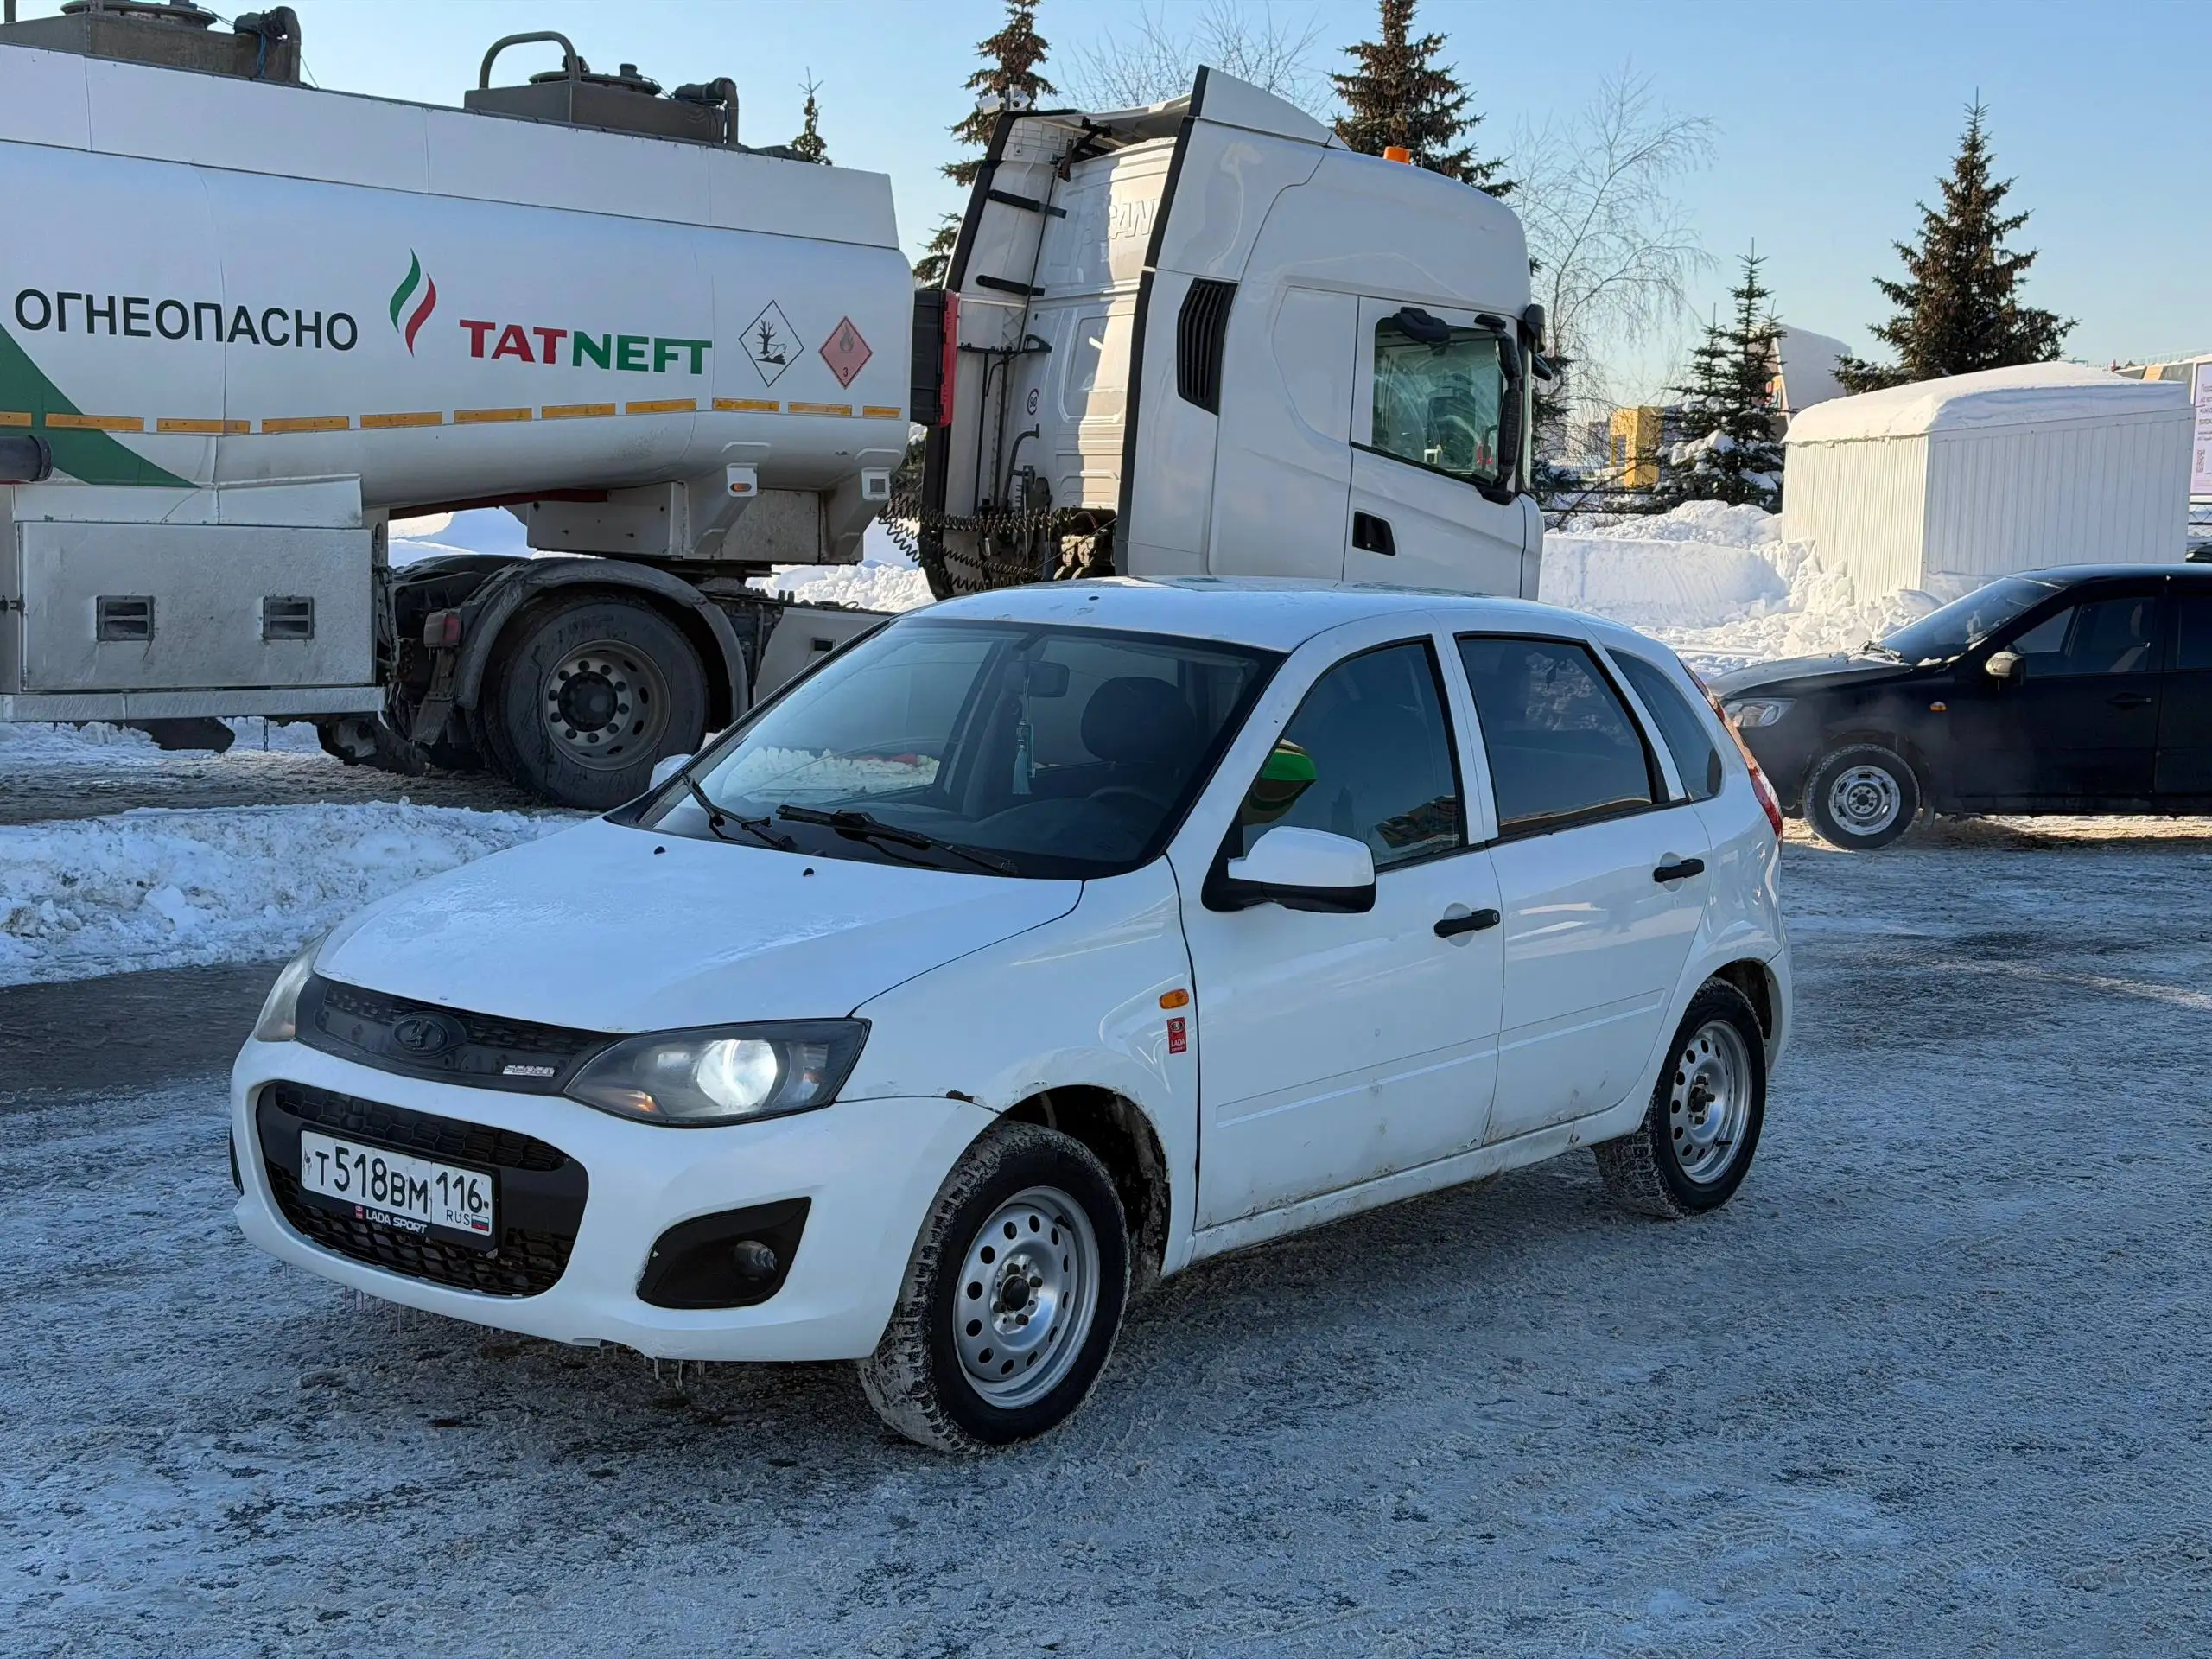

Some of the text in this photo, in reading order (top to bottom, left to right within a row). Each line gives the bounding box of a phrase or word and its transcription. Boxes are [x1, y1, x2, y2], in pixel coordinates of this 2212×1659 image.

[14, 288, 358, 352] ОГНЕОПАСНО
[459, 318, 713, 375] TATNEFT
[842, 366, 849, 378] 3
[1170, 1037, 1186, 1048] LADA
[435, 1171, 483, 1214] 116
[365, 1208, 428, 1234] LADA SPORT
[446, 1209, 471, 1226] RUS
